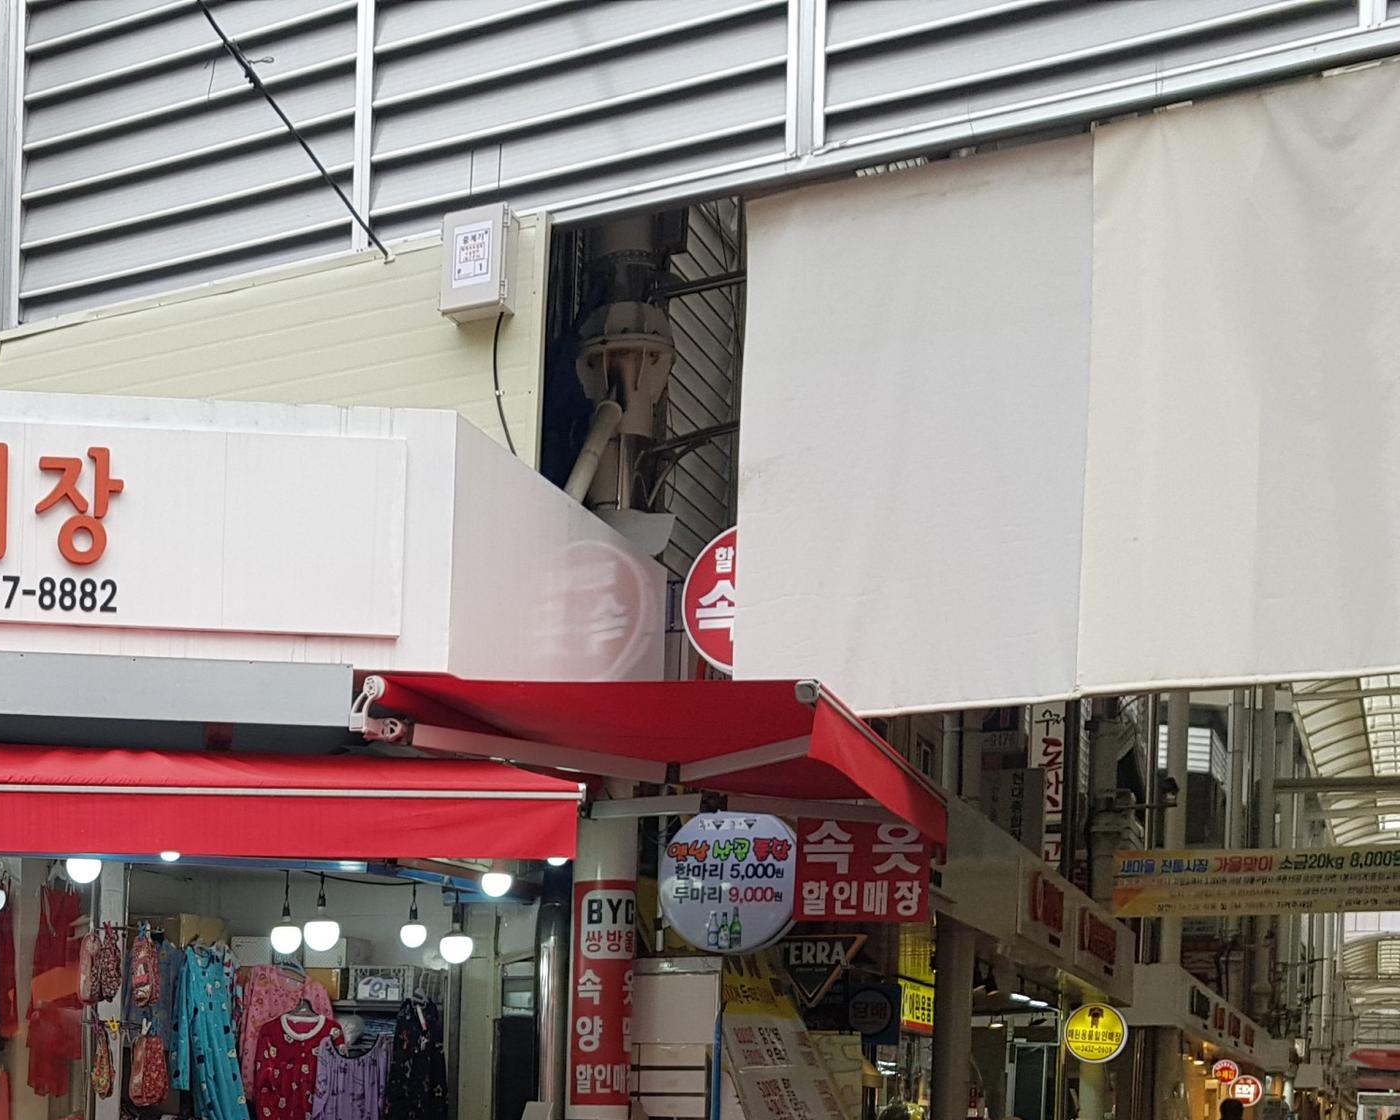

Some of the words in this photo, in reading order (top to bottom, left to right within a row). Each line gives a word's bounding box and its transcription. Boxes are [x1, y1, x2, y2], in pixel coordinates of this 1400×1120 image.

[803, 820, 924, 875] 속옷
[675, 862, 724, 880] 한마리
[673, 884, 722, 904] 두마리
[802, 880, 922, 916] 할인매장
[575, 1063, 631, 1094] 할인매
